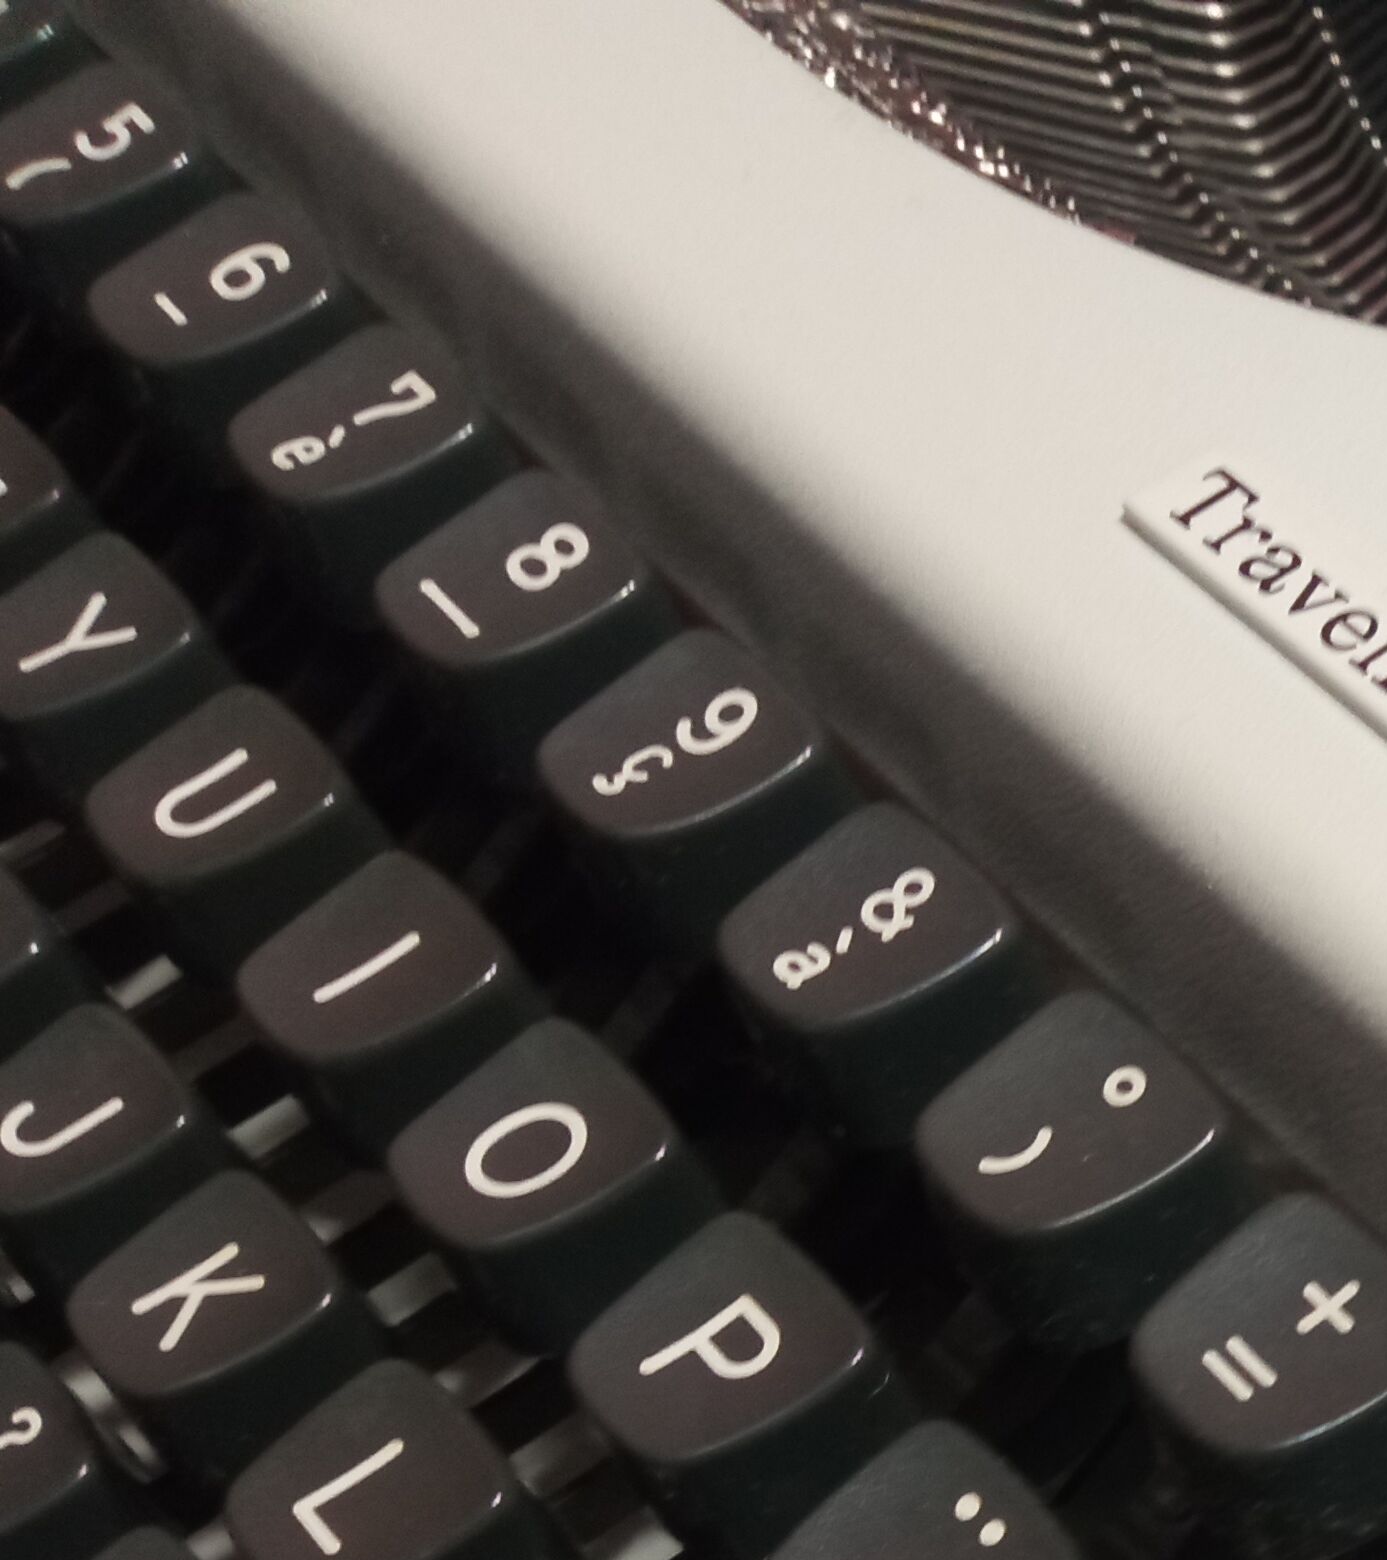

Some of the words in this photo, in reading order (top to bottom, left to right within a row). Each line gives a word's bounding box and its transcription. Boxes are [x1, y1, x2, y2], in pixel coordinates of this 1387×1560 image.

[74, 103, 155, 161] 5
[209, 243, 290, 301] 6
[353, 370, 437, 426] 7
[505, 523, 590, 591] 8
[18, 592, 137, 673] Y
[675, 688, 758, 755] 9
[154, 748, 277, 838] U
[592, 745, 674, 796] ç
[860, 868, 935, 943] &
[0, 1097, 124, 1157] J
[464, 1102, 588, 1198] O
[131, 1242, 265, 1352] K
[1296, 1281, 1360, 1334] +
[639, 1294, 781, 1379] P
[1201, 1336, 1277, 1401] =
[292, 1439, 404, 1555] L
